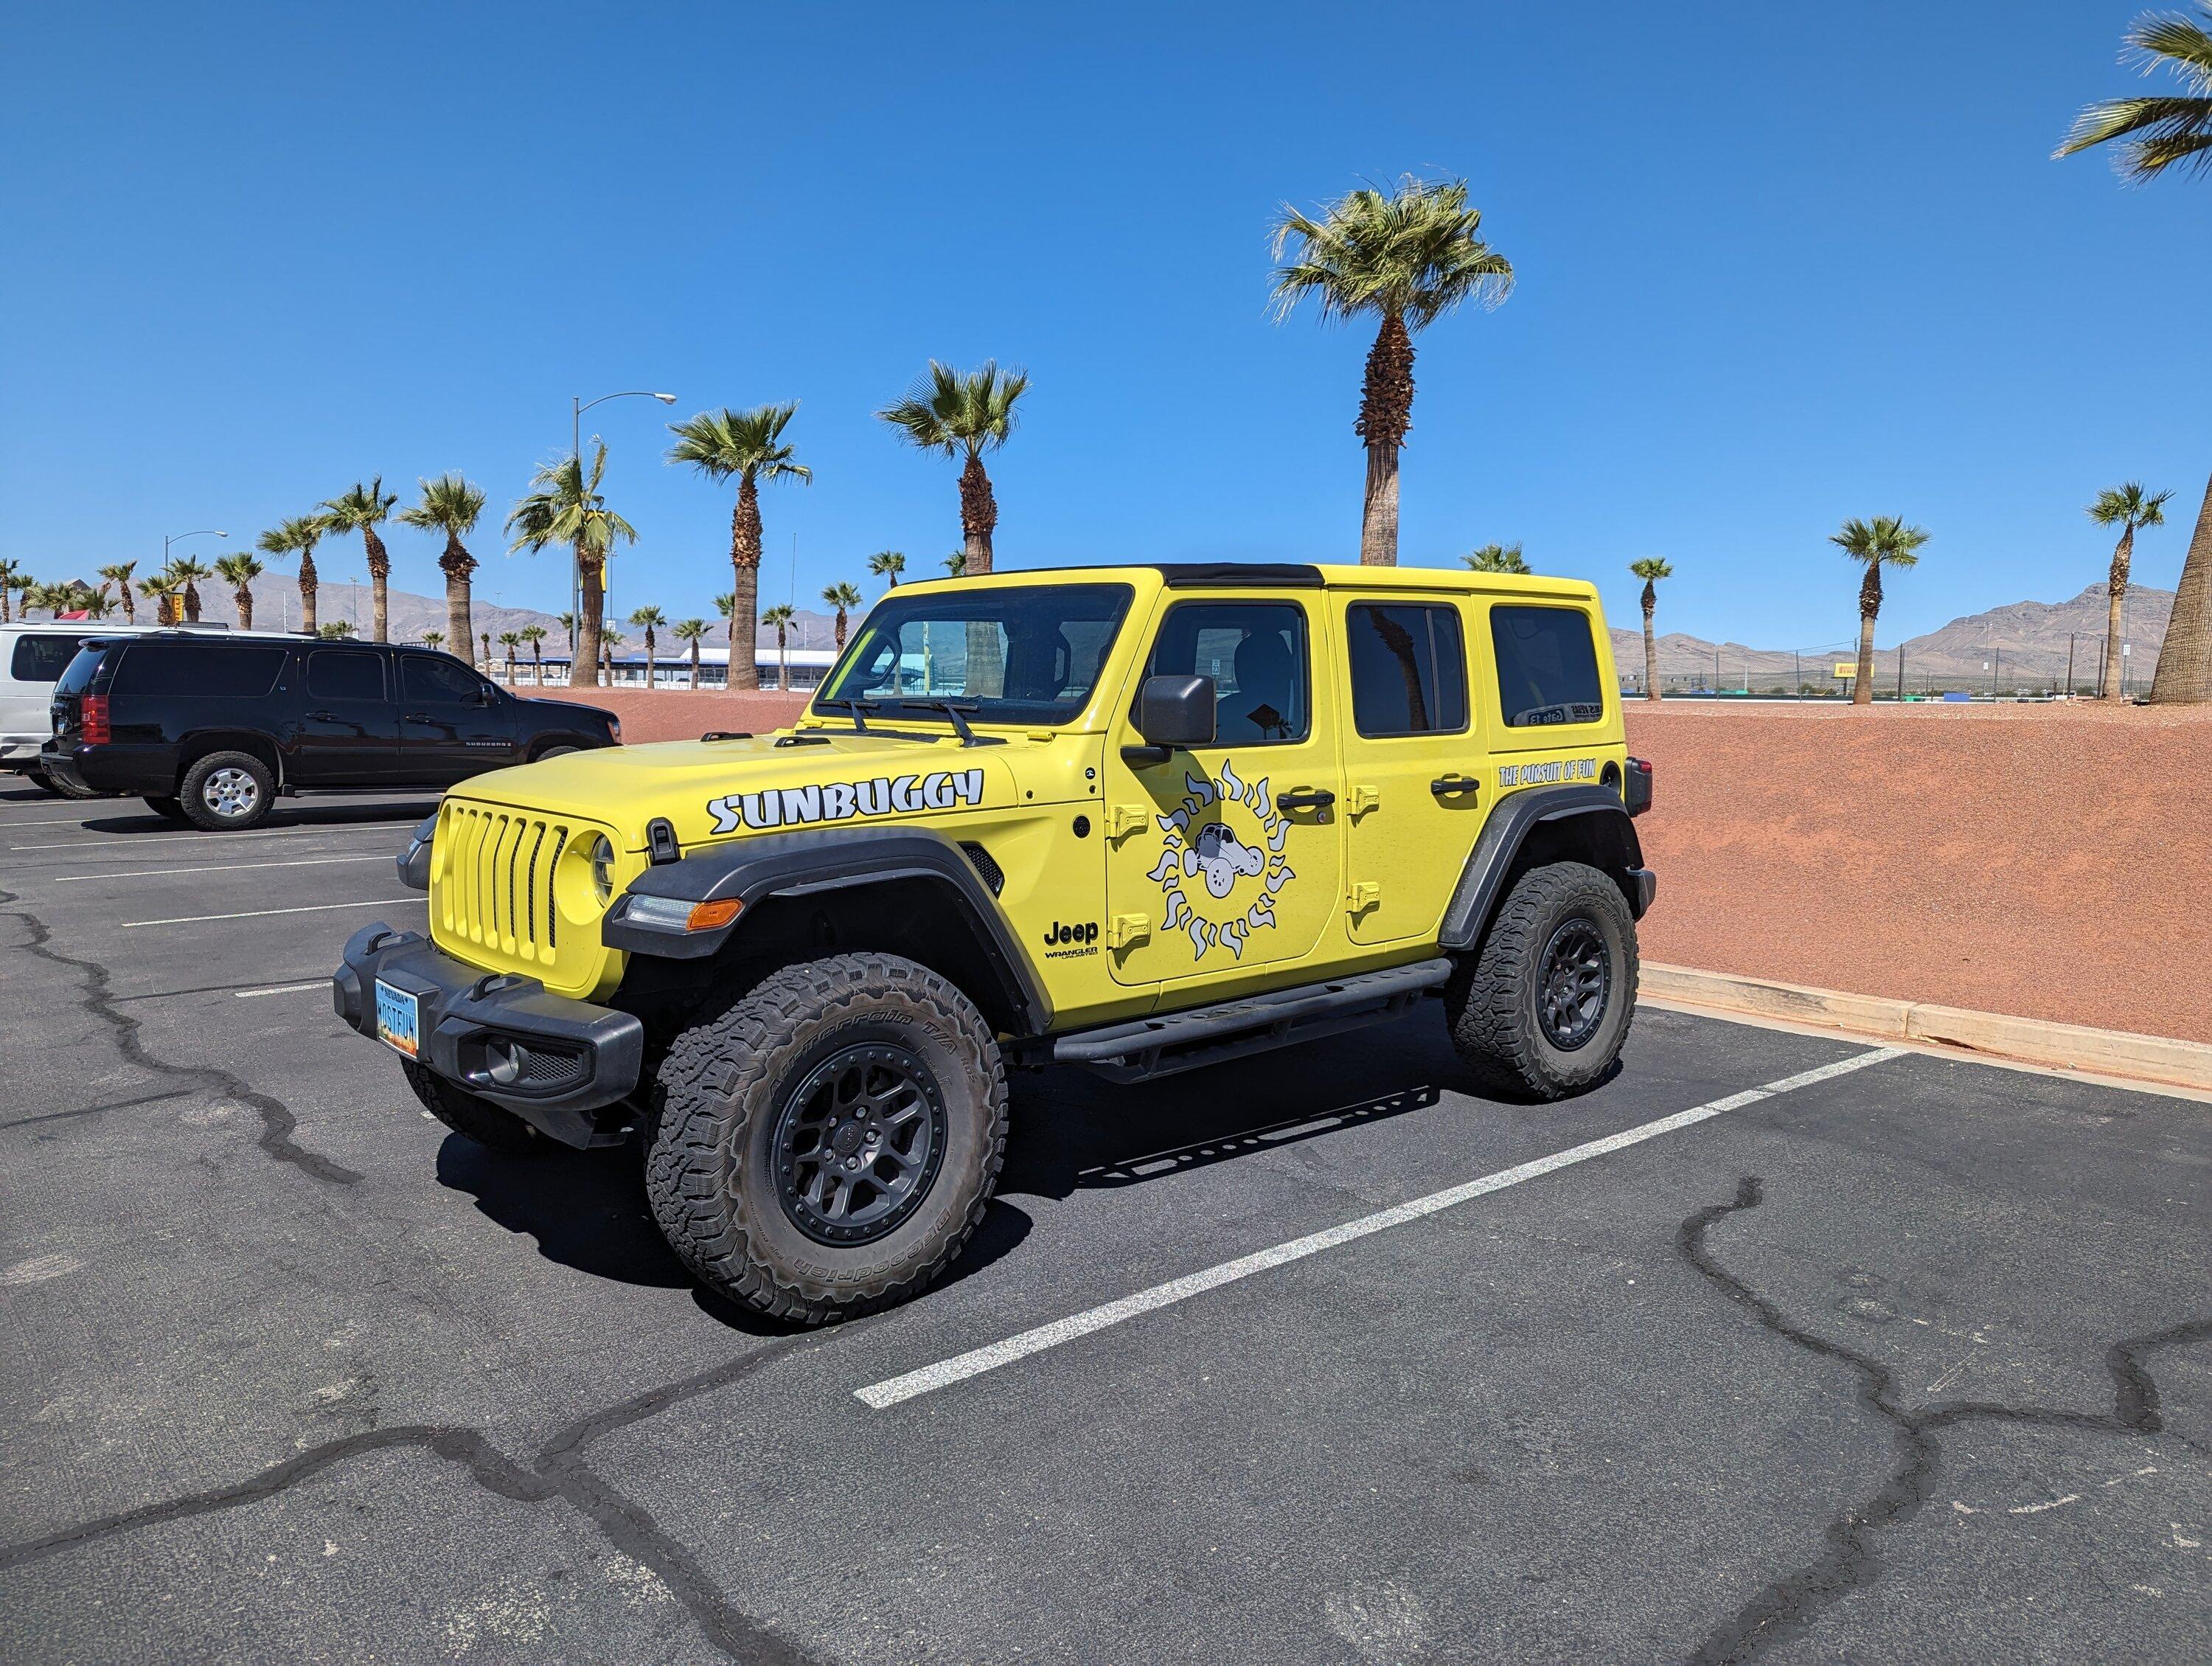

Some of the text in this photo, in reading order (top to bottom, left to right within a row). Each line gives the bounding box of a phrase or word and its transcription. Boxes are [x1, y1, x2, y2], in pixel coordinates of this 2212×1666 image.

[1213, 665, 1219, 673] 23
[1499, 758, 1596, 787] THE PURSUIT OF FUN
[706, 768, 984, 836] SUNBUGGY
[1044, 921, 1098, 946] Jeep
[1045, 947, 1097, 958] WRANGLER
[384, 988, 406, 1005] NEVADA
[378, 999, 415, 1043] MOSTFUN
[921, 1021, 958, 1055] T/A
[793, 1207, 952, 1283] BFGoodrich
